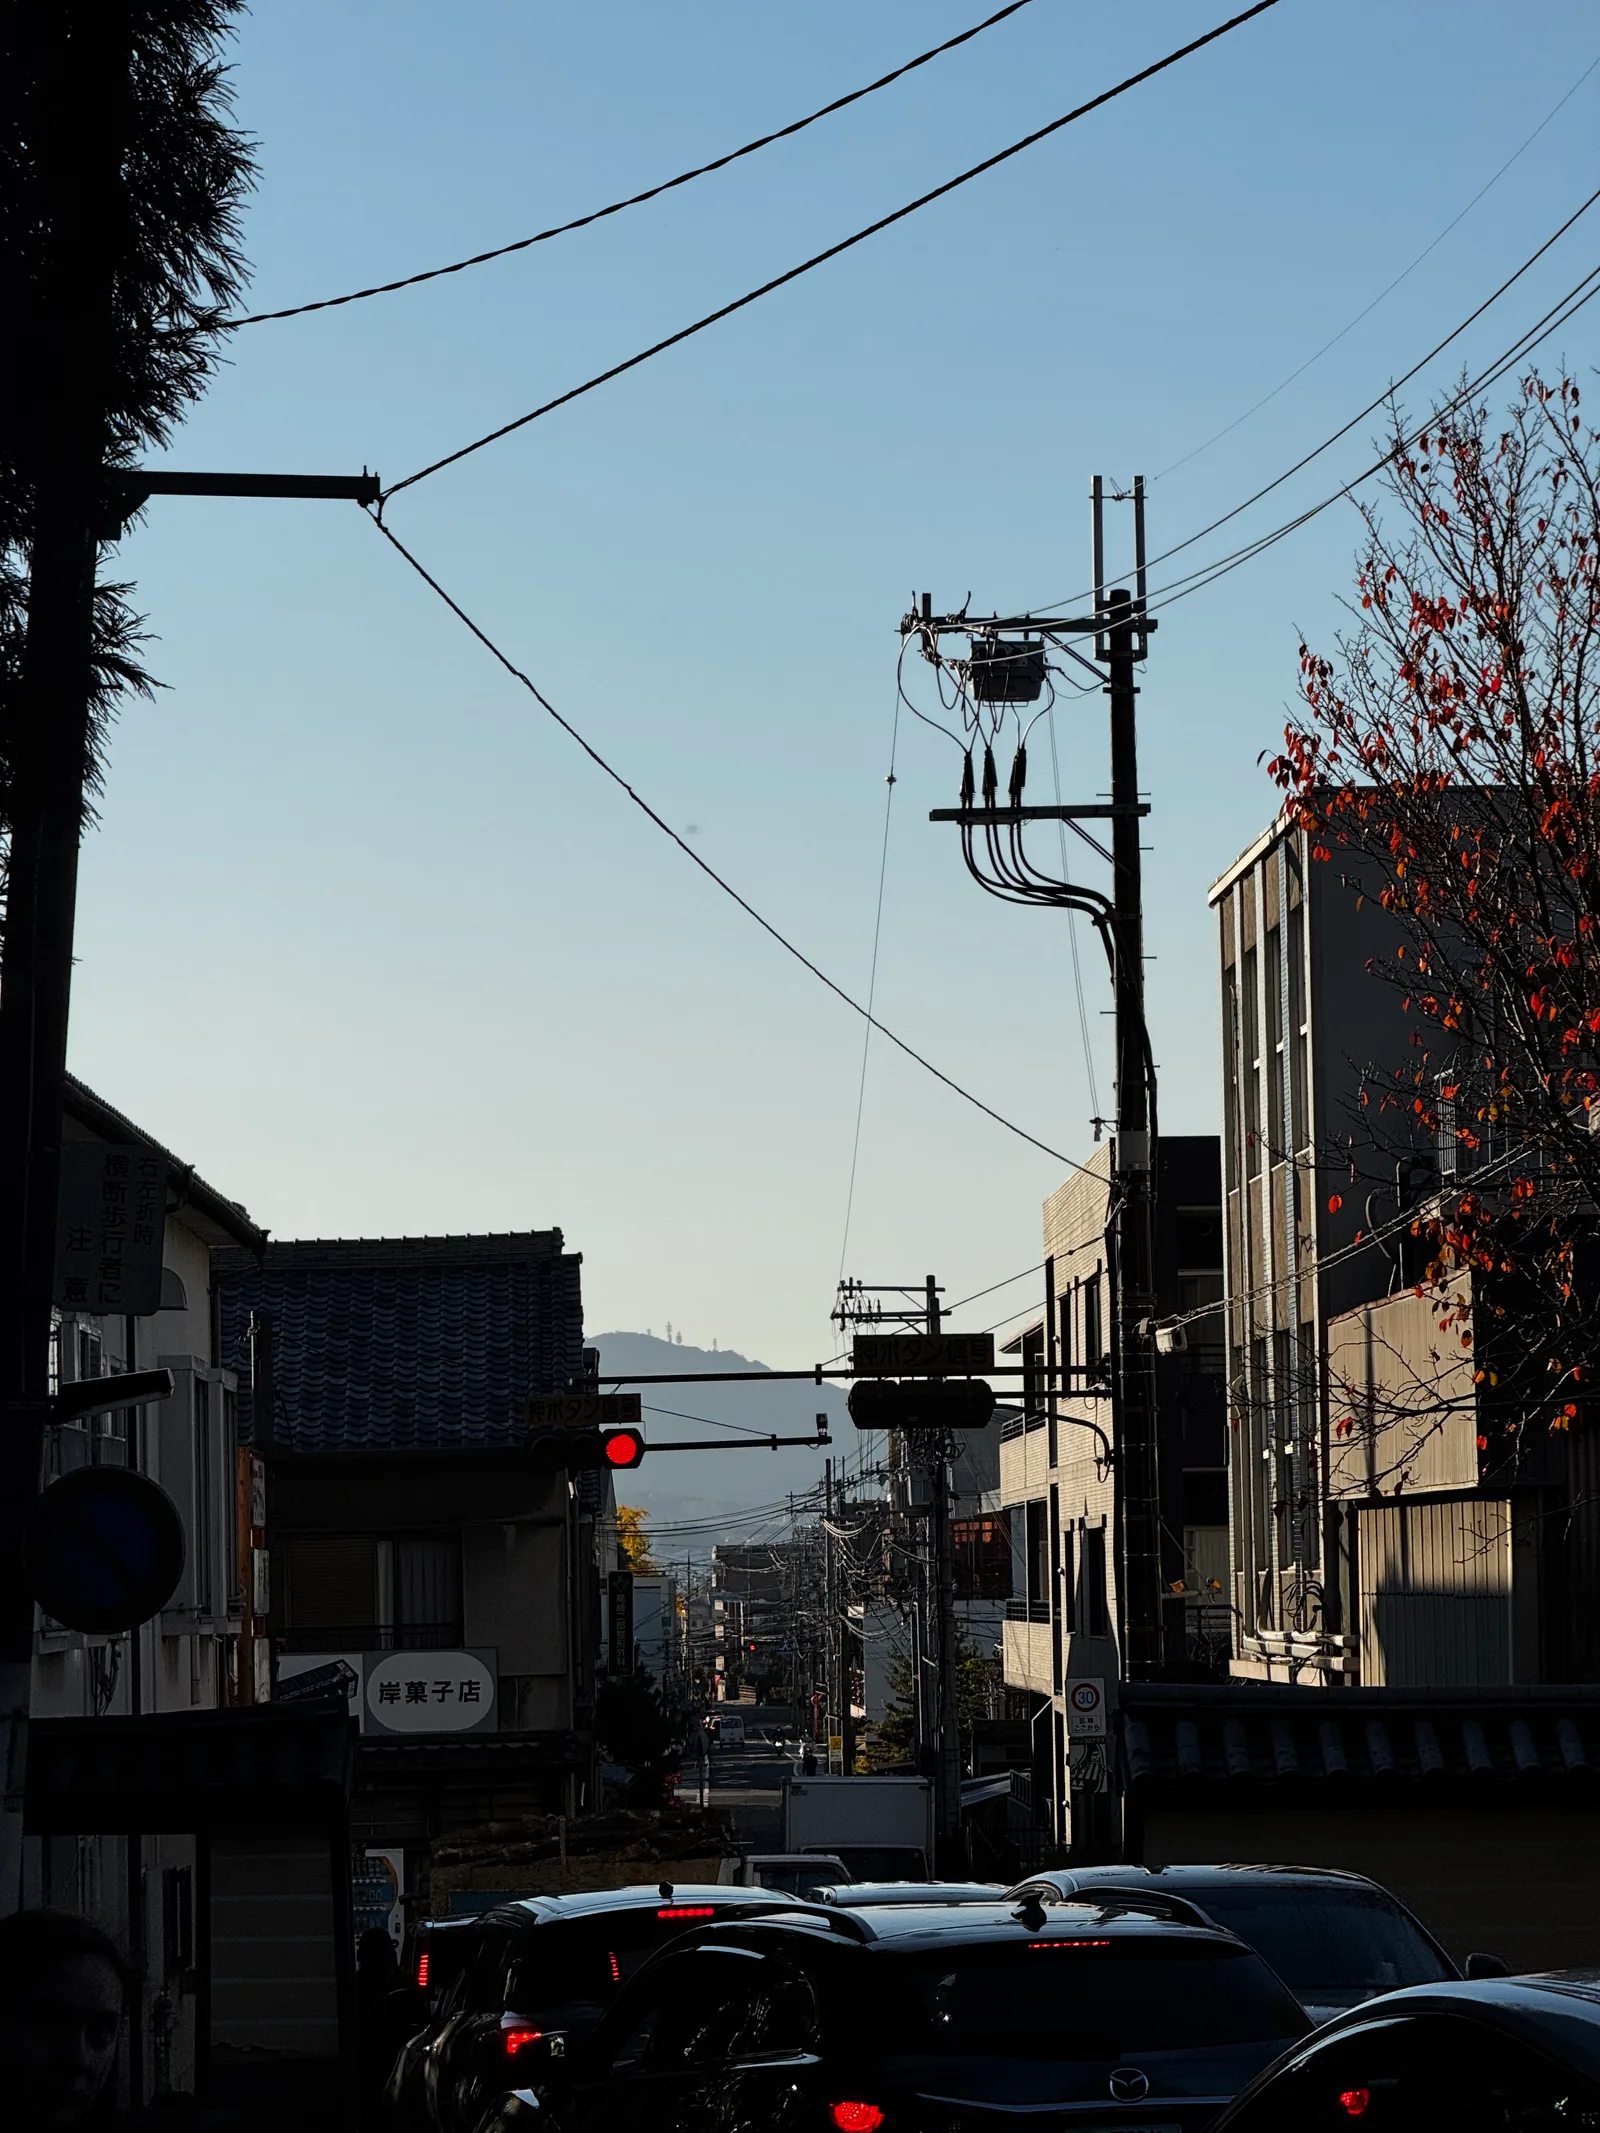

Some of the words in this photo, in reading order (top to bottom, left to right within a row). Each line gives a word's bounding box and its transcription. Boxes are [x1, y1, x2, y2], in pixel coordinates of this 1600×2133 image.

[133, 1157, 159, 1245] 右左折時
[99, 1153, 131, 1304] 横断歩行者に
[62, 1224, 92, 1303] 注意
[854, 1338, 989, 1367] 押ボタン信号
[528, 1397, 637, 1422] 押ボタン信号
[378, 1679, 481, 1705] 岸菓子店
[1078, 1691, 1094, 1704] 30
